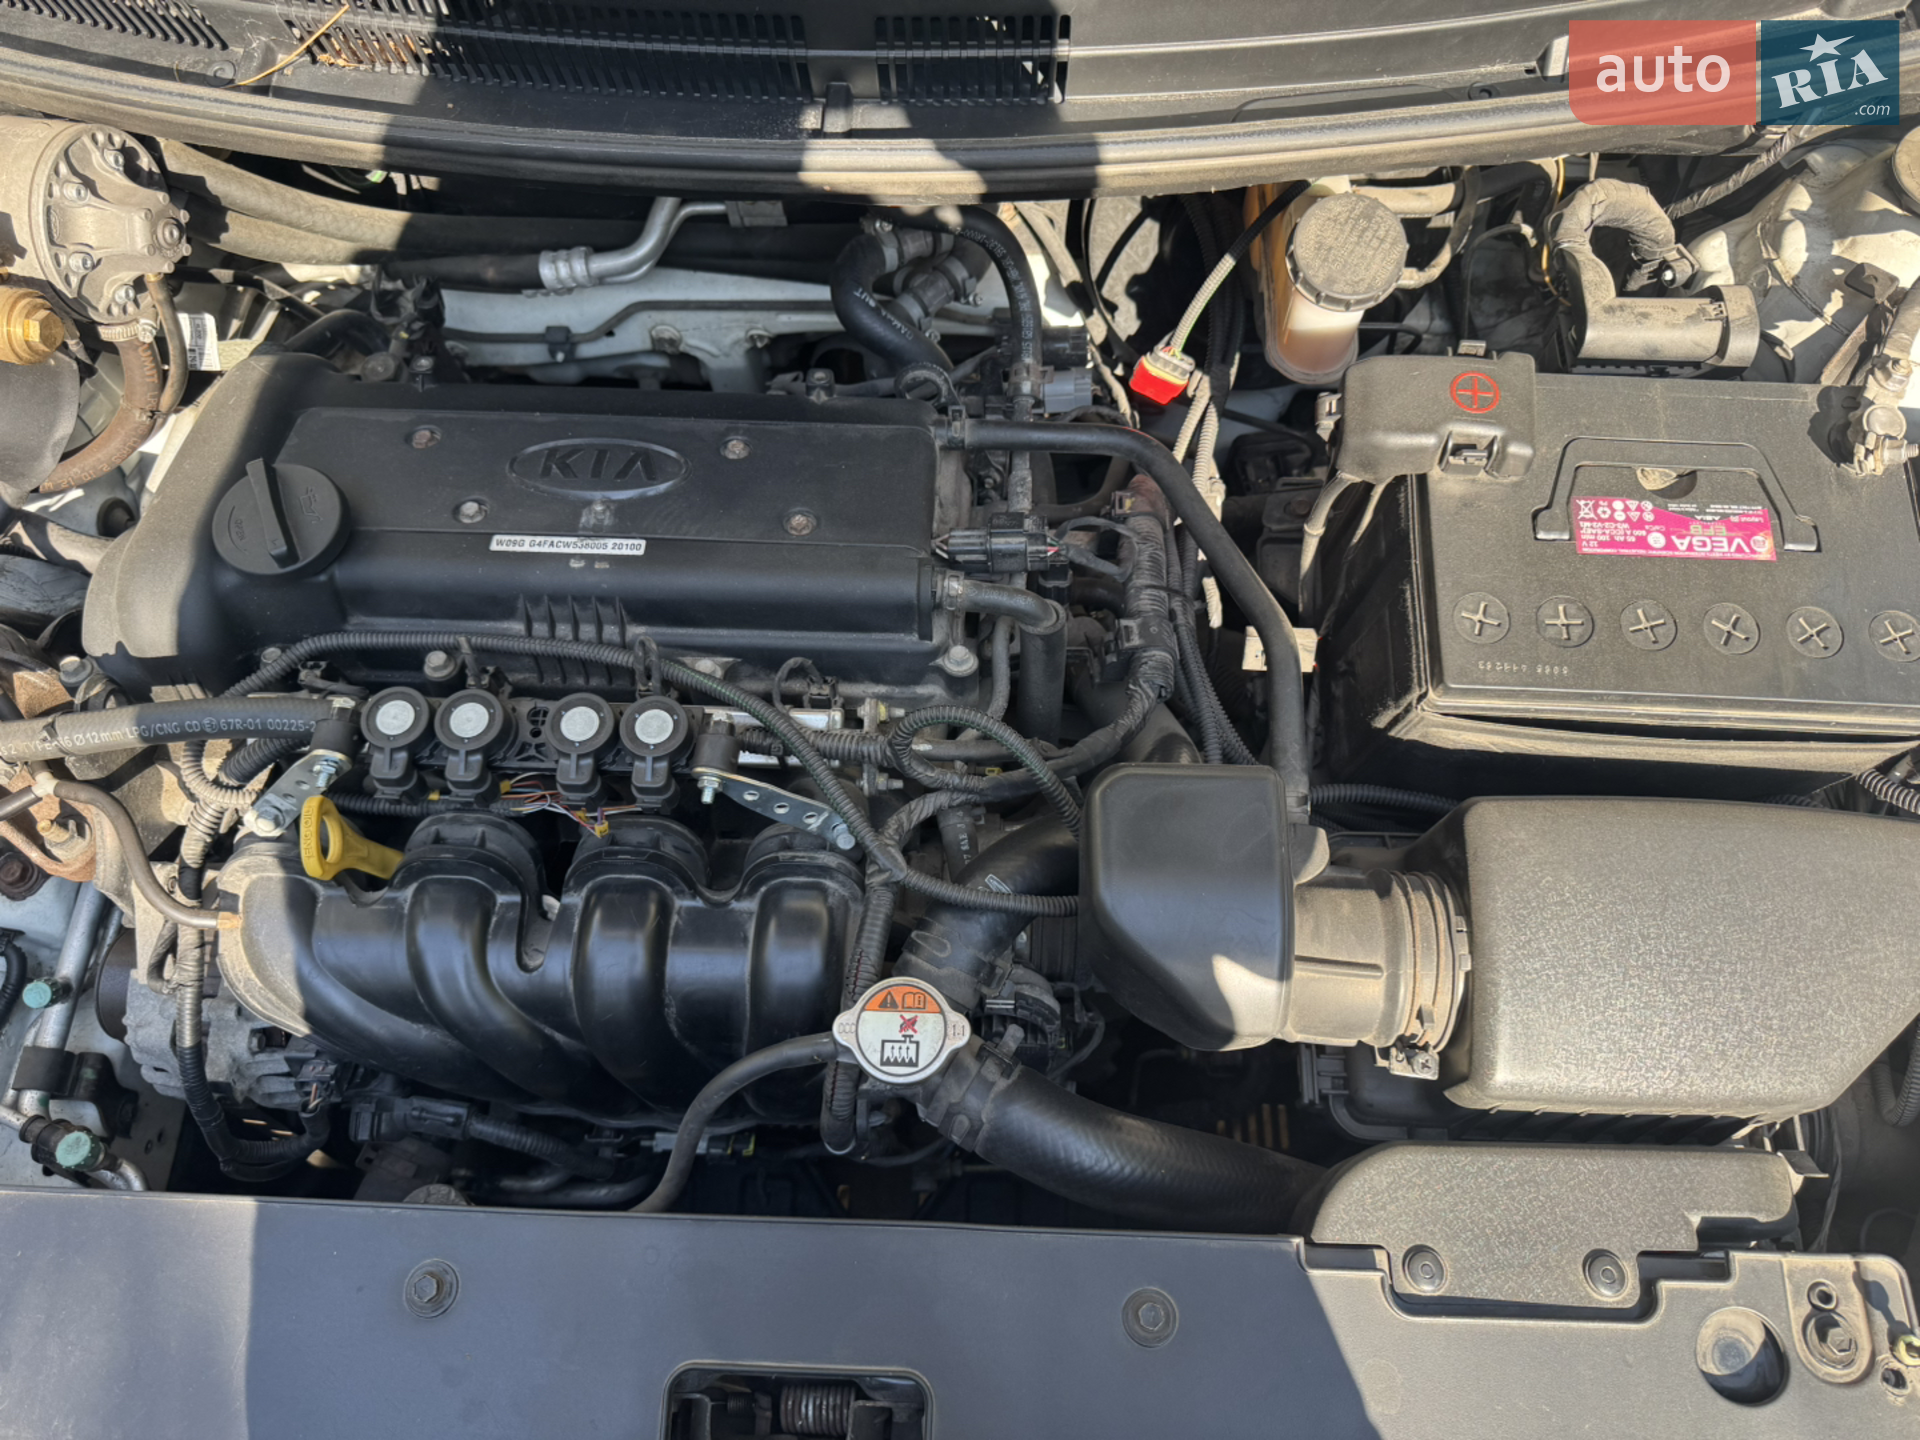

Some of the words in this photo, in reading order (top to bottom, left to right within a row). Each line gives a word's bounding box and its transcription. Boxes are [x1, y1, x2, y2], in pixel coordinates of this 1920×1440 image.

[539, 449, 658, 482] KIA
[1690, 525, 1727, 536] EFB
[495, 538, 526, 548] W09G
[611, 542, 643, 552] 20100
[1671, 535, 1751, 553] VEGA
[125, 721, 181, 739] LPG/CNG
[184, 720, 201, 732] CD
[219, 718, 262, 731] 67R-01
[952, 1024, 965, 1037] 1.1
